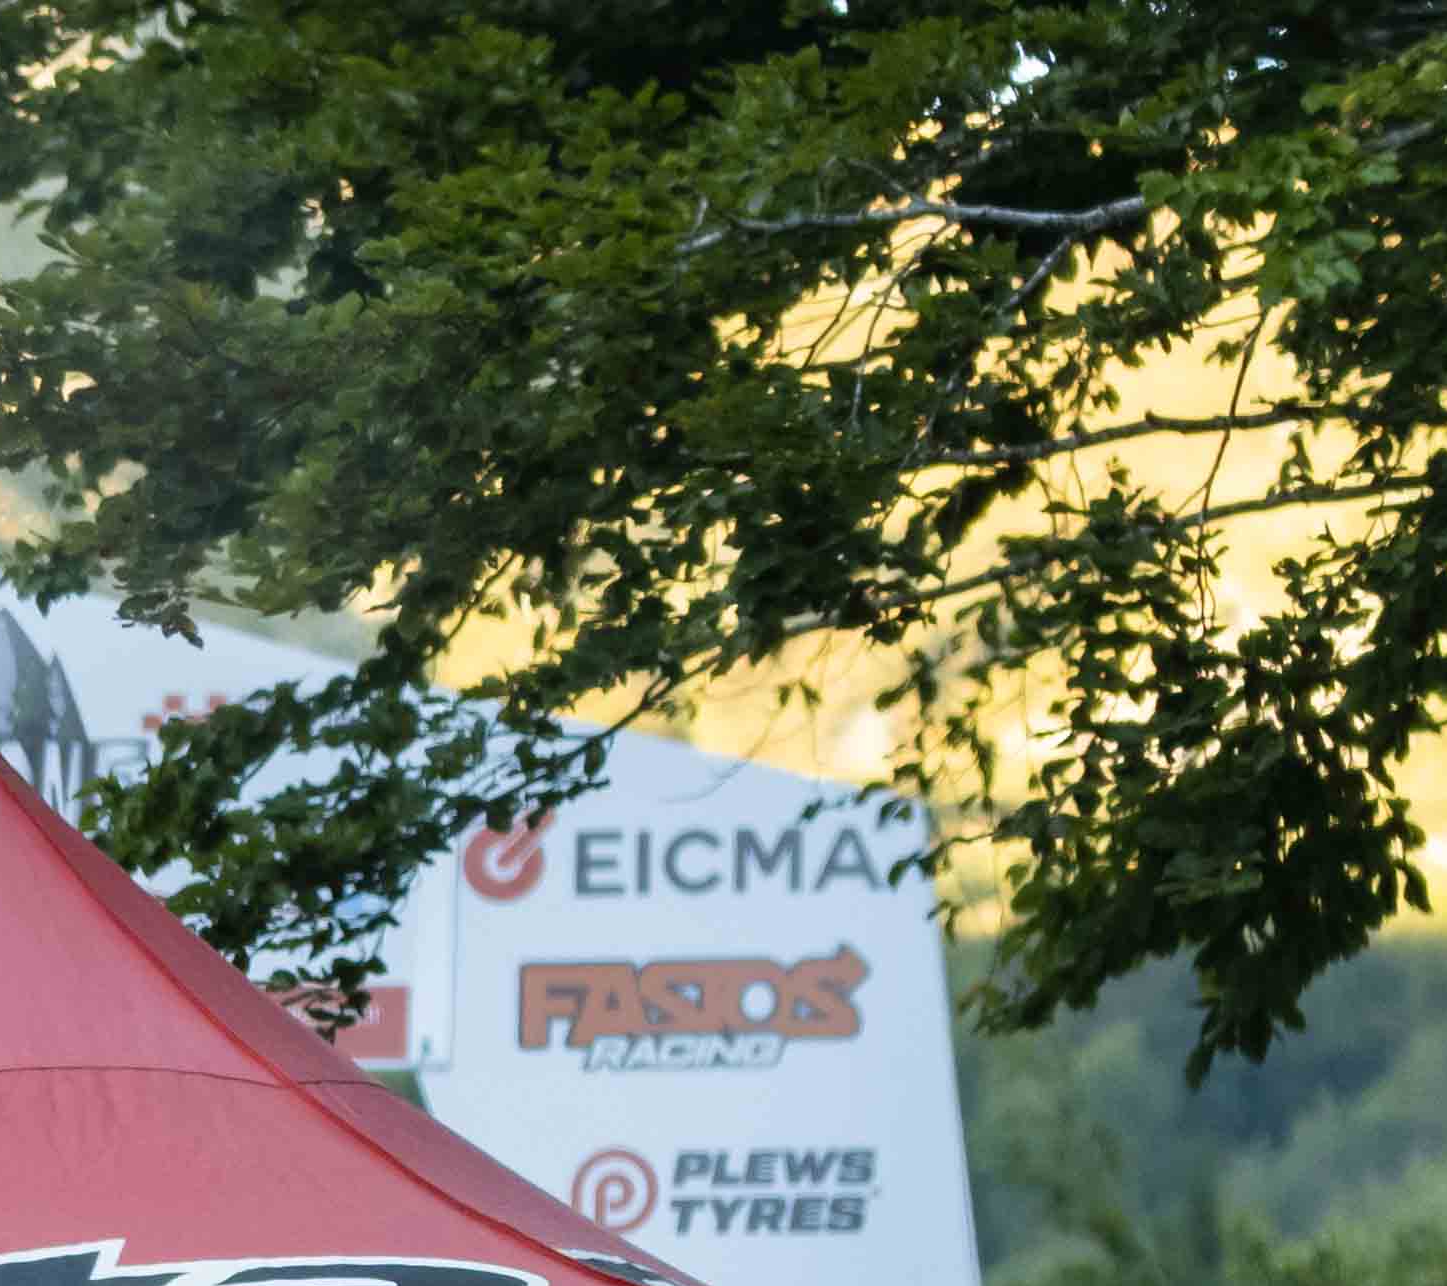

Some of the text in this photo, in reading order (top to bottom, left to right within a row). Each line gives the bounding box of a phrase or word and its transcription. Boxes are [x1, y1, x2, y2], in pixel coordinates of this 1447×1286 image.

[574, 822, 882, 895] EICMA
[581, 1033, 786, 1074] RACING
[672, 1148, 875, 1186] PLEWS
[671, 1195, 866, 1235] TYRES
